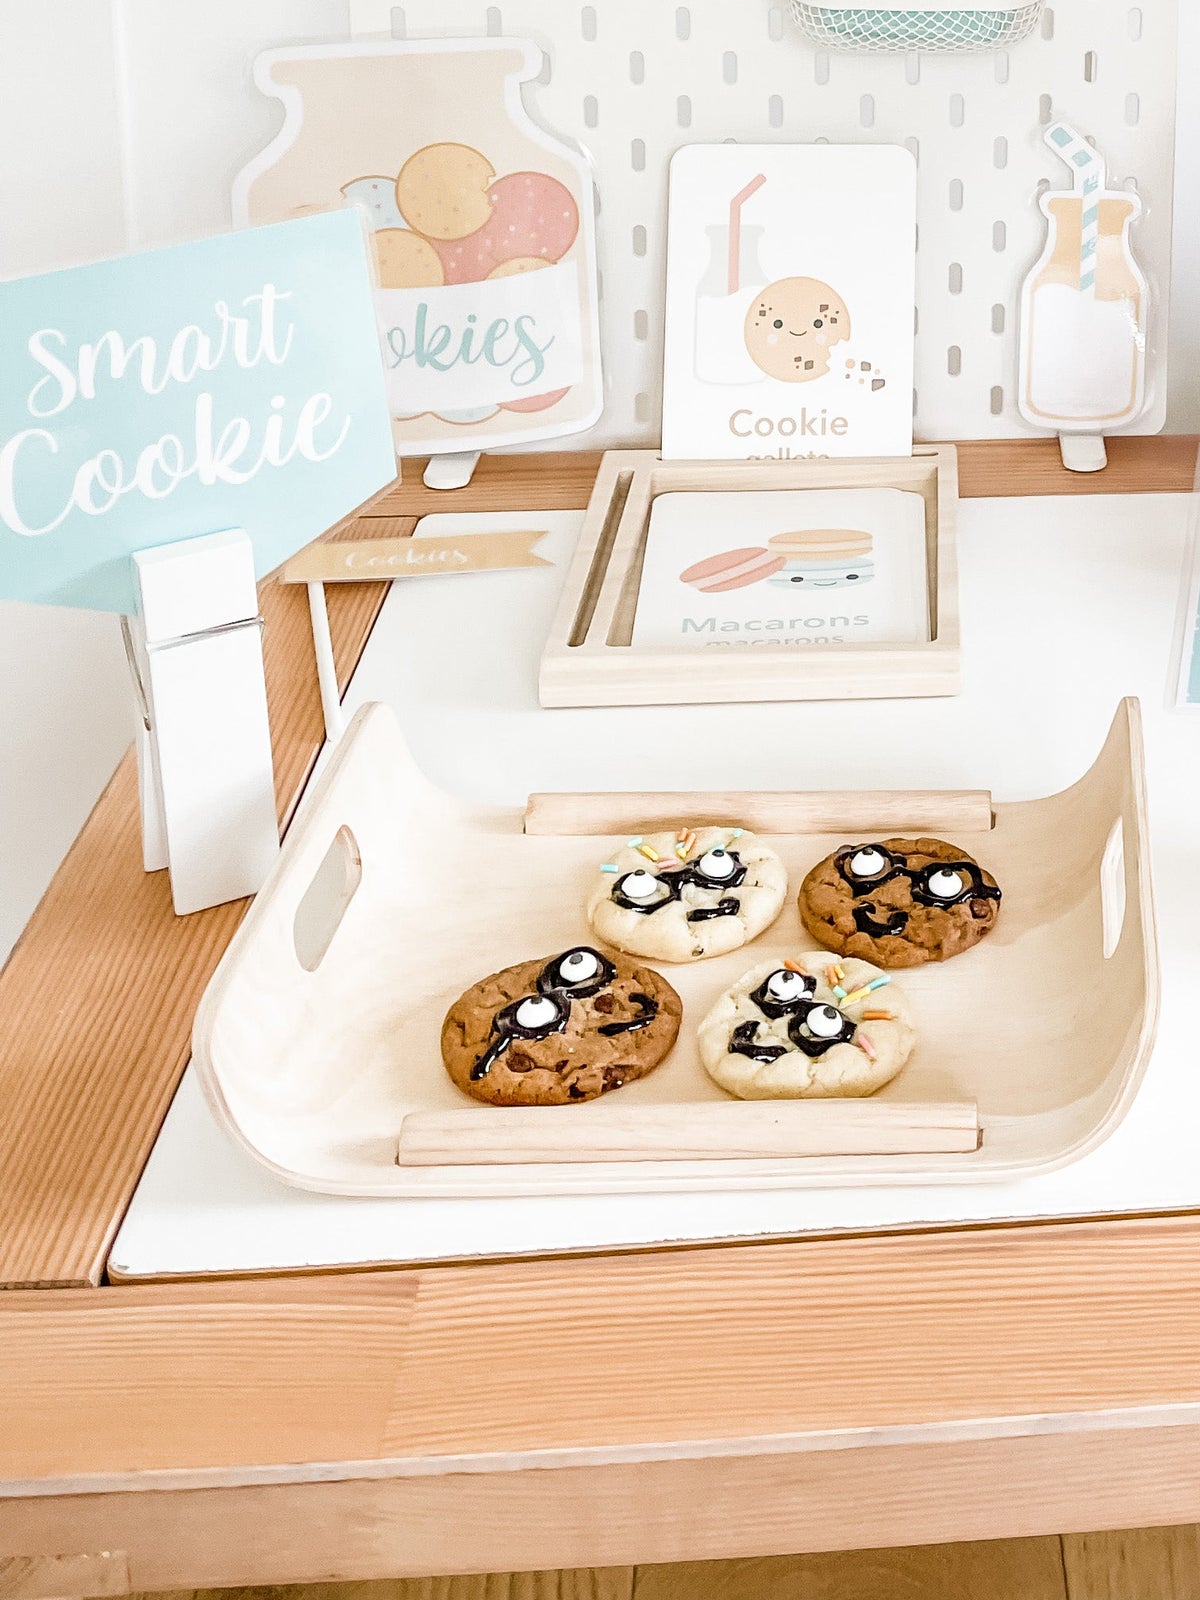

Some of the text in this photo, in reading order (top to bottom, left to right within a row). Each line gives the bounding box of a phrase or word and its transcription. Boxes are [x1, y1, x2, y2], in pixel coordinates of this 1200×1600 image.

[728, 406, 849, 438] Cookie
[0, 391, 352, 538] Cookie
[681, 614, 870, 634] Macarons
